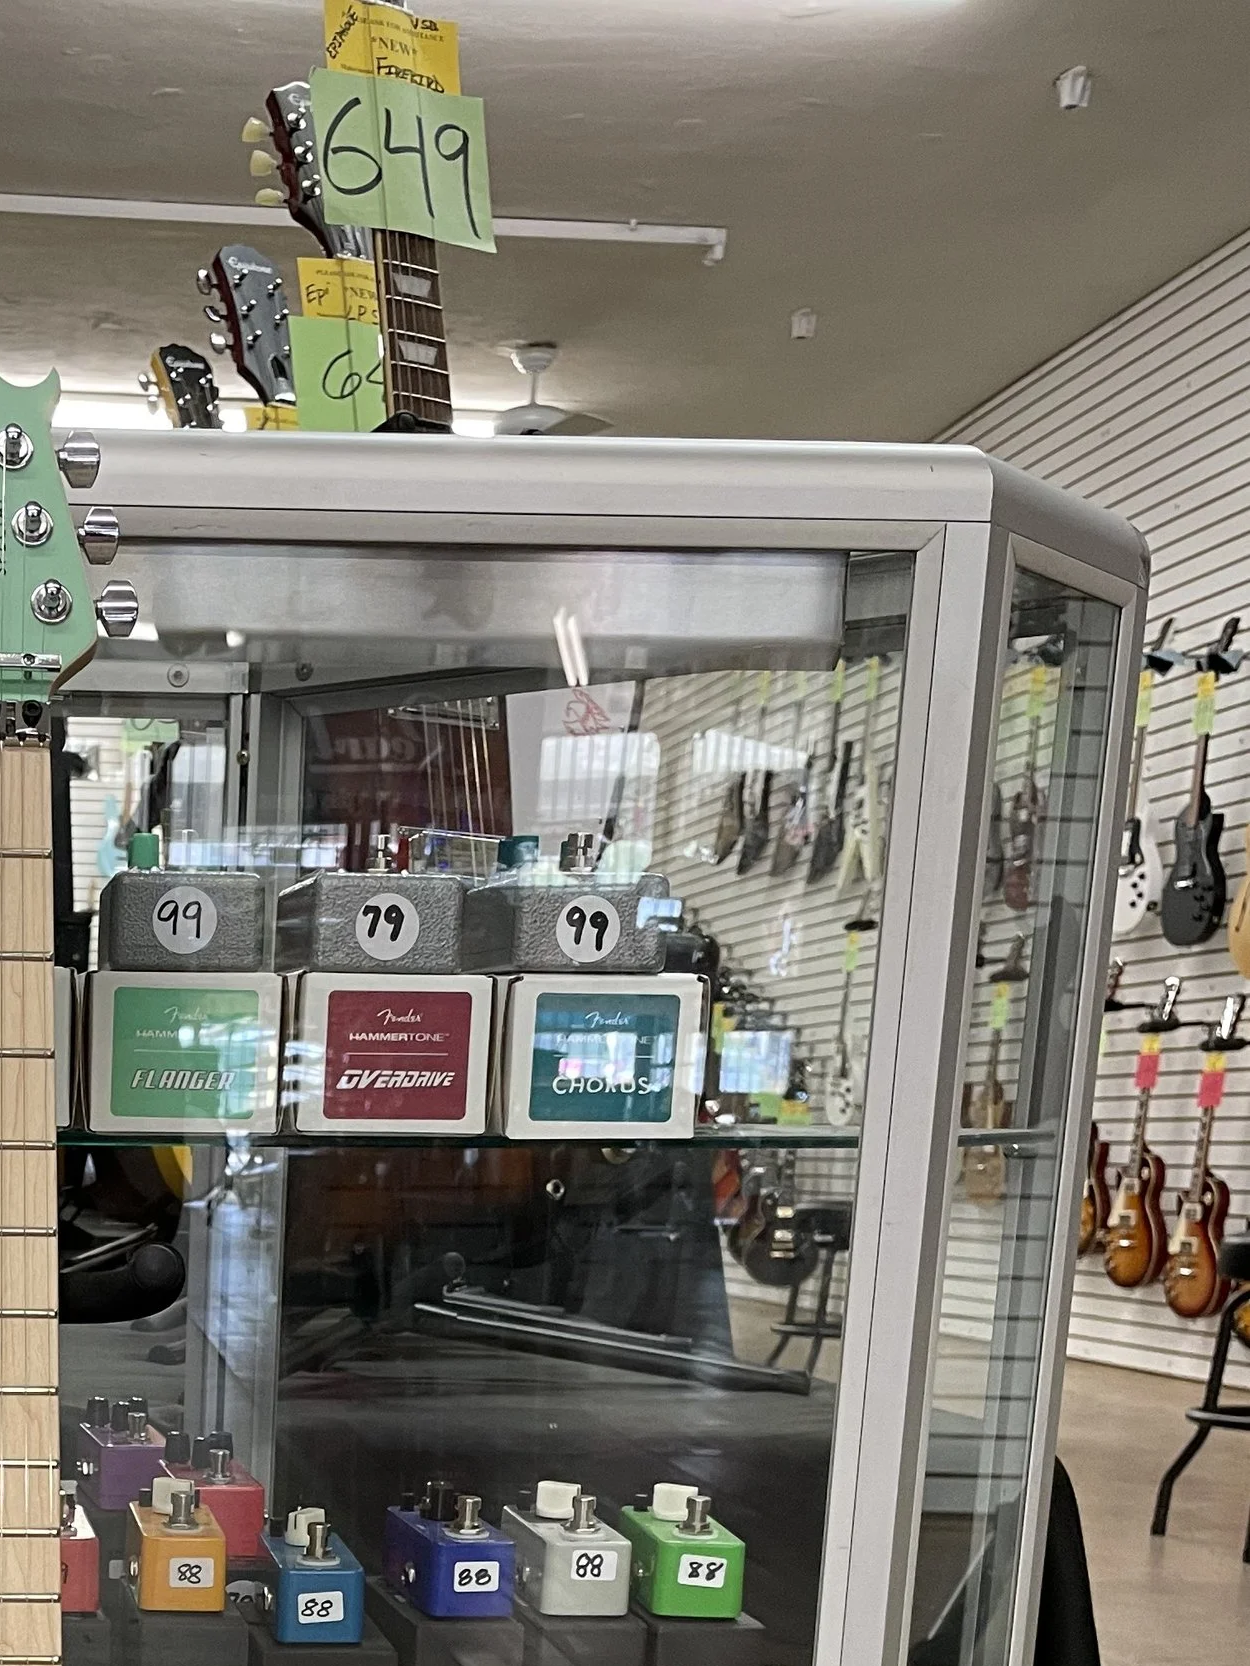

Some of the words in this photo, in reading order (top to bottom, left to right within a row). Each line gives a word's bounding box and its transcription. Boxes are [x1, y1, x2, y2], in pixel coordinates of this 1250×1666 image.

[322, 96, 481, 239] 649
[157, 899, 203, 939] 99
[362, 904, 405, 942] 79
[565, 905, 609, 952] 99
[376, 1008, 423, 1026] Fender
[584, 1010, 631, 1029] Fender
[131, 1068, 236, 1091] FLANGER
[335, 1068, 456, 1090] OVERDRIVE
[551, 1075, 651, 1096] CHORUS
[177, 1563, 202, 1584] 88
[575, 1552, 604, 1578] 88
[687, 1560, 724, 1582] 88
[456, 1567, 492, 1587] 88
[300, 1598, 334, 1618] 88
